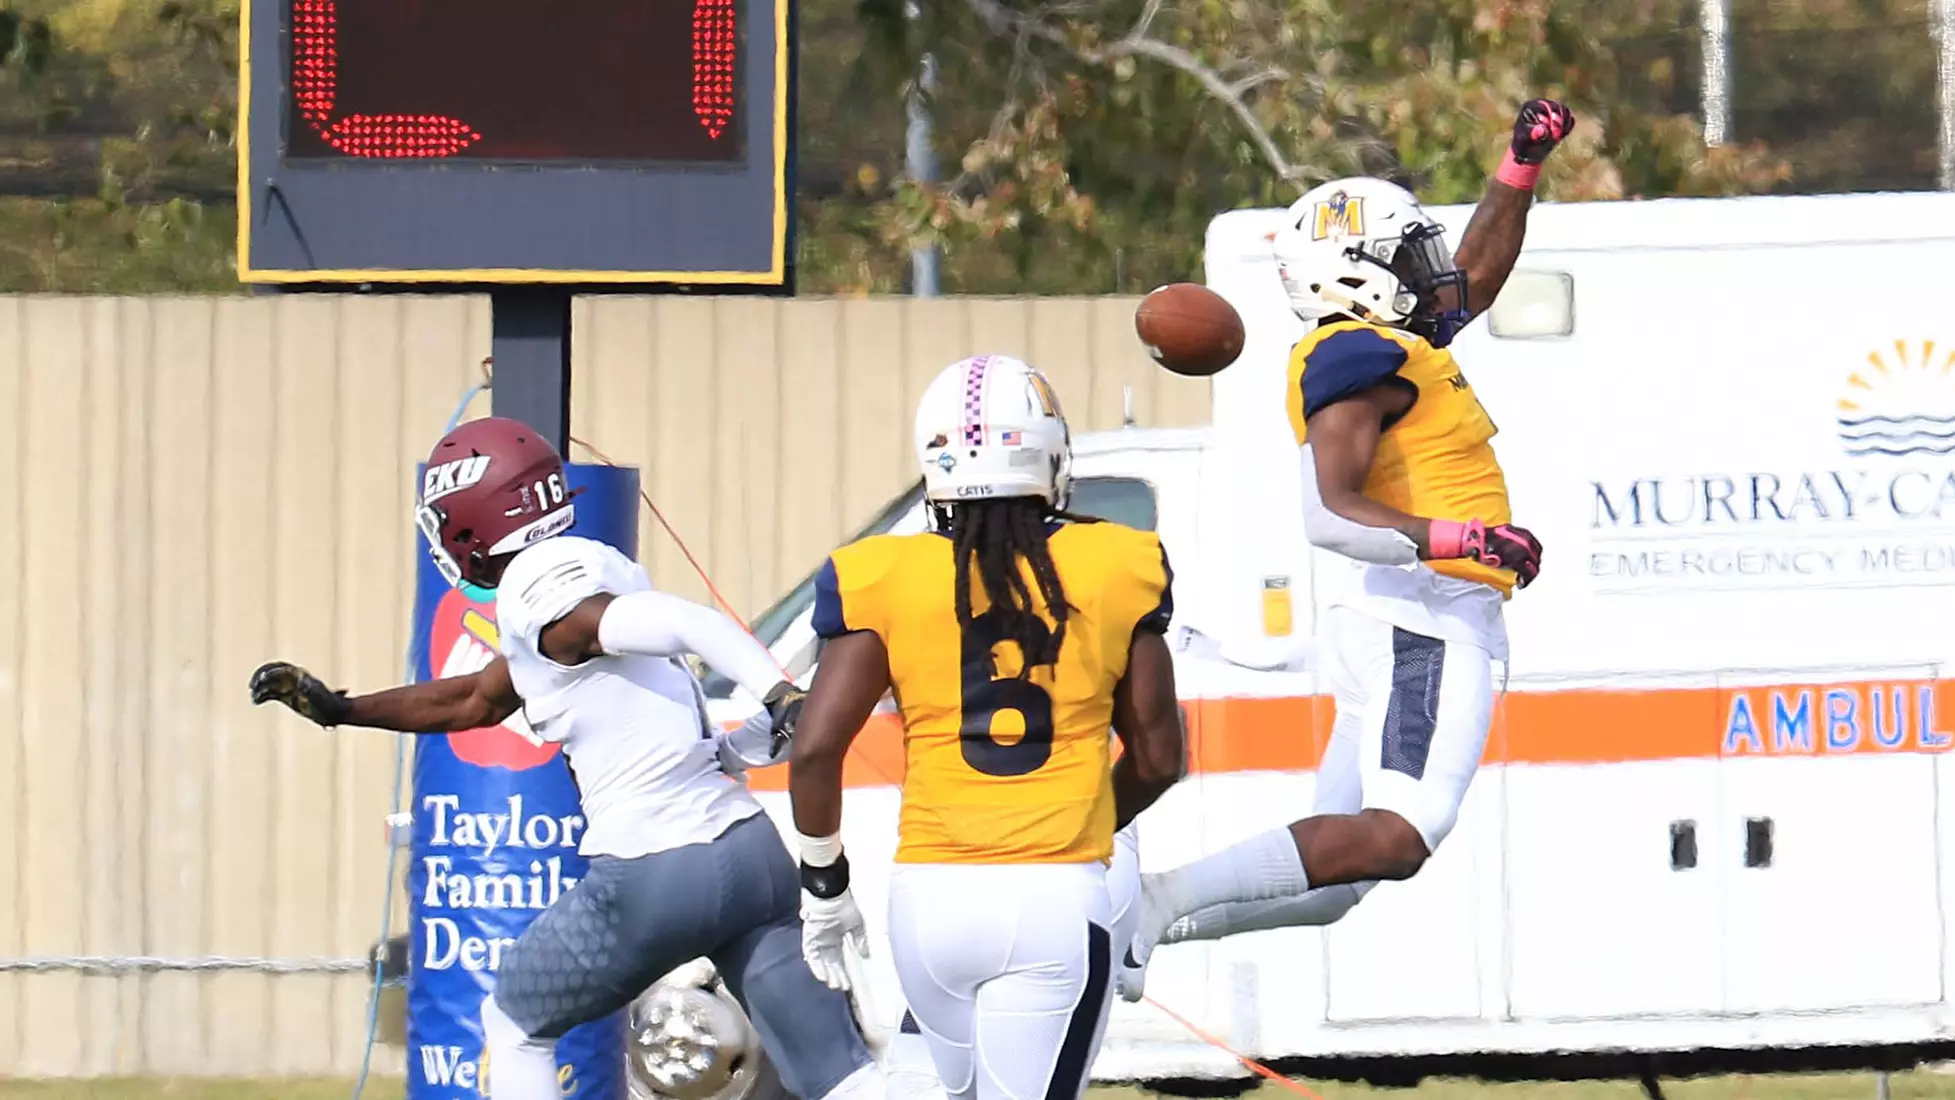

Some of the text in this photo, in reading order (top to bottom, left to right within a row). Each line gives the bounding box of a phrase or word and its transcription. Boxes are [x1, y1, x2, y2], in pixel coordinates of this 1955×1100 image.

[424, 455, 491, 502] EKU
[534, 473, 563, 511] 16
[1588, 547, 1842, 577] EMERGENCY
[1724, 686, 1951, 751] AMBUL
[422, 793, 585, 856] Taylor
[419, 1044, 477, 1088] We
